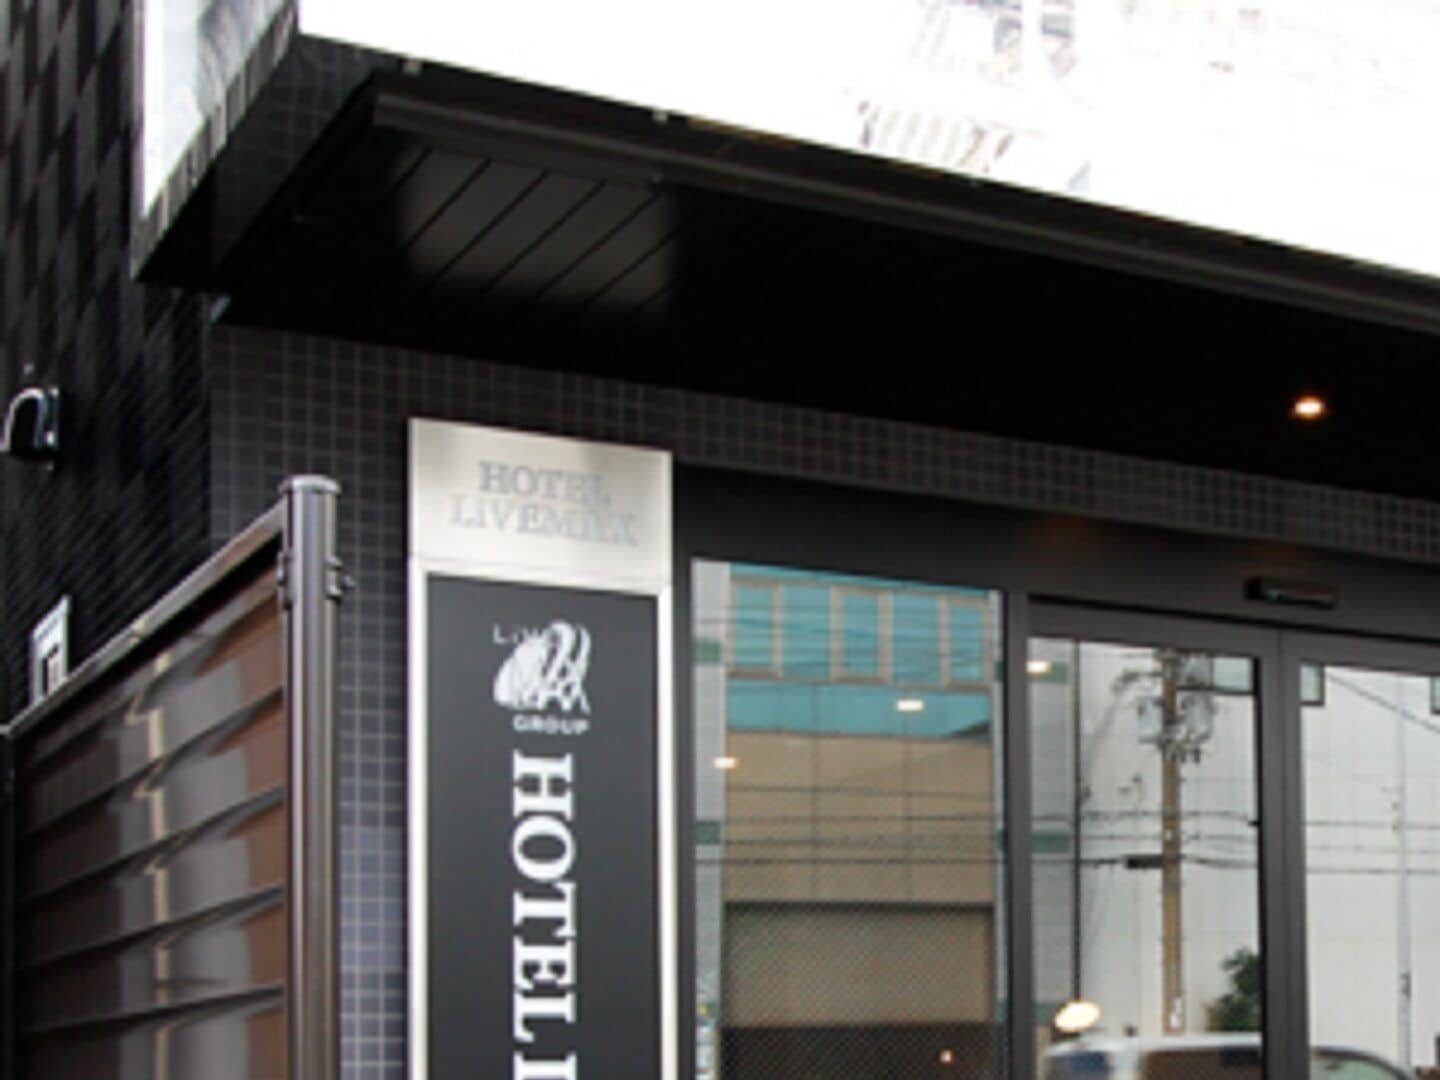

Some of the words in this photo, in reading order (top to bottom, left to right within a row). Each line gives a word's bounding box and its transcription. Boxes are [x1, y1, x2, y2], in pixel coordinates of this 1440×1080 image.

[478, 460, 612, 505] HOTEL
[513, 714, 590, 735] GROUP
[512, 749, 578, 1043] HOTEL
